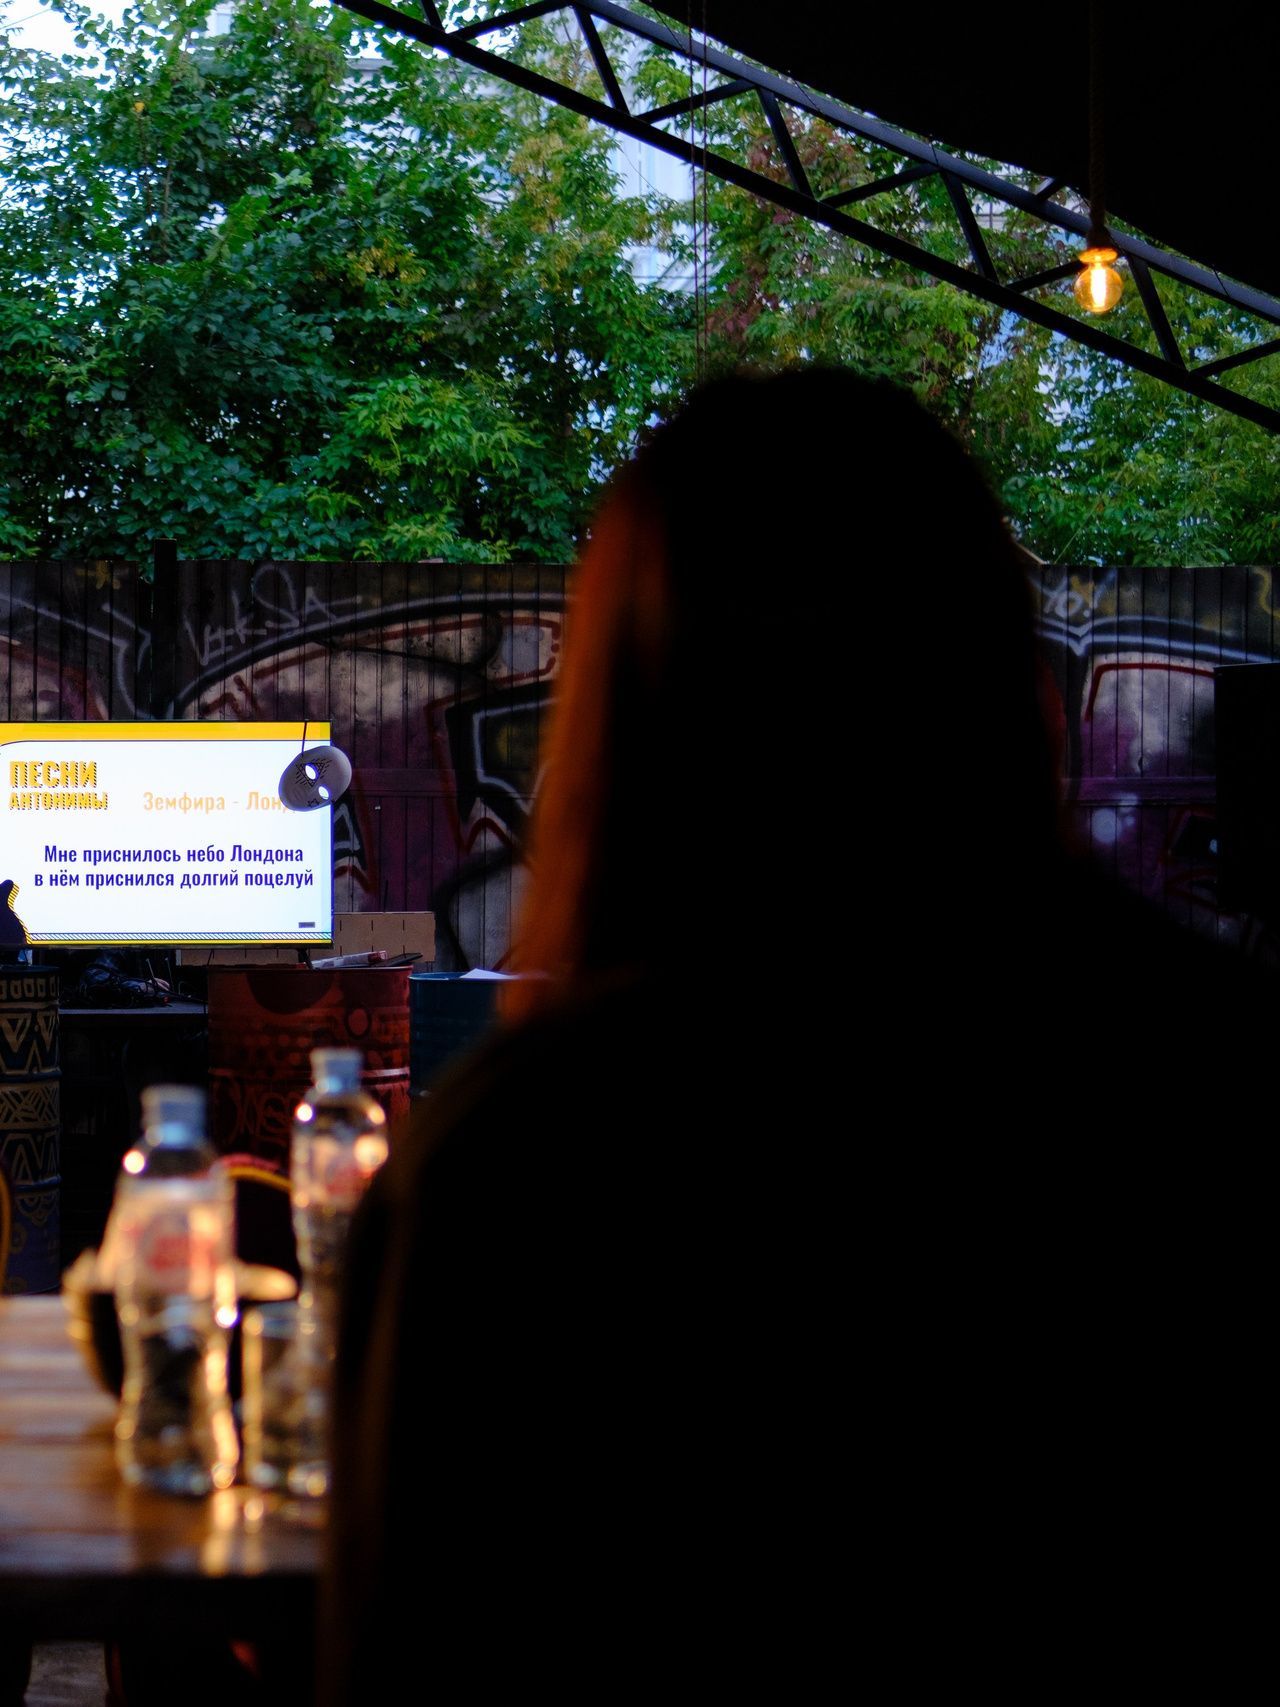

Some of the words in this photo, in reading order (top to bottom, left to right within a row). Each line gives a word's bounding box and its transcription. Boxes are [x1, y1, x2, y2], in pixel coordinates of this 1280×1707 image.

[9, 760, 98, 789] ПЕСНИ
[8, 791, 109, 811] АНТОНИМЫ
[143, 791, 226, 815] Земфира
[246, 791, 296, 815] Лон
[44, 845, 77, 863] Мне
[83, 849, 181, 866] приснилось
[187, 844, 225, 862] небо
[229, 844, 304, 865] Лондона
[34, 873, 44, 887] в
[49, 869, 80, 887] нём
[85, 873, 175, 891] приснился
[180, 869, 239, 889] долгий
[244, 869, 314, 889] поцелуй
